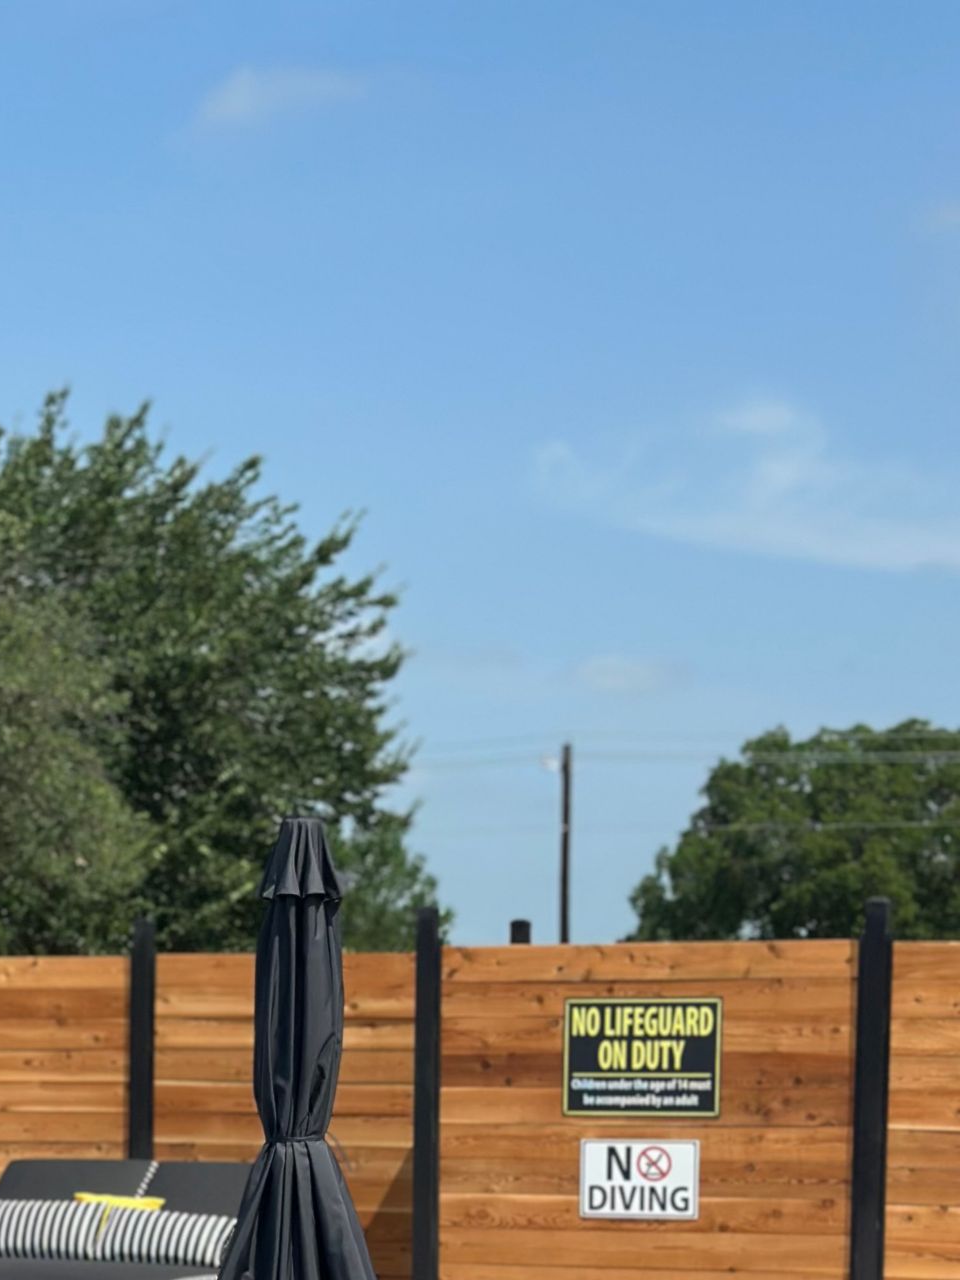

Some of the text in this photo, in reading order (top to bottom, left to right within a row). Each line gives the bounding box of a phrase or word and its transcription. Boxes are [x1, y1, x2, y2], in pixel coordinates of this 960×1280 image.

[572, 1006, 714, 1037] NO LIFEGUARD
[598, 1041, 686, 1070] ON DUTY
[571, 1078, 712, 1094] Children under the age of 14 must
[583, 1094, 699, 1108] be accompanied by an adult
[589, 1185, 689, 1212] DIVING
